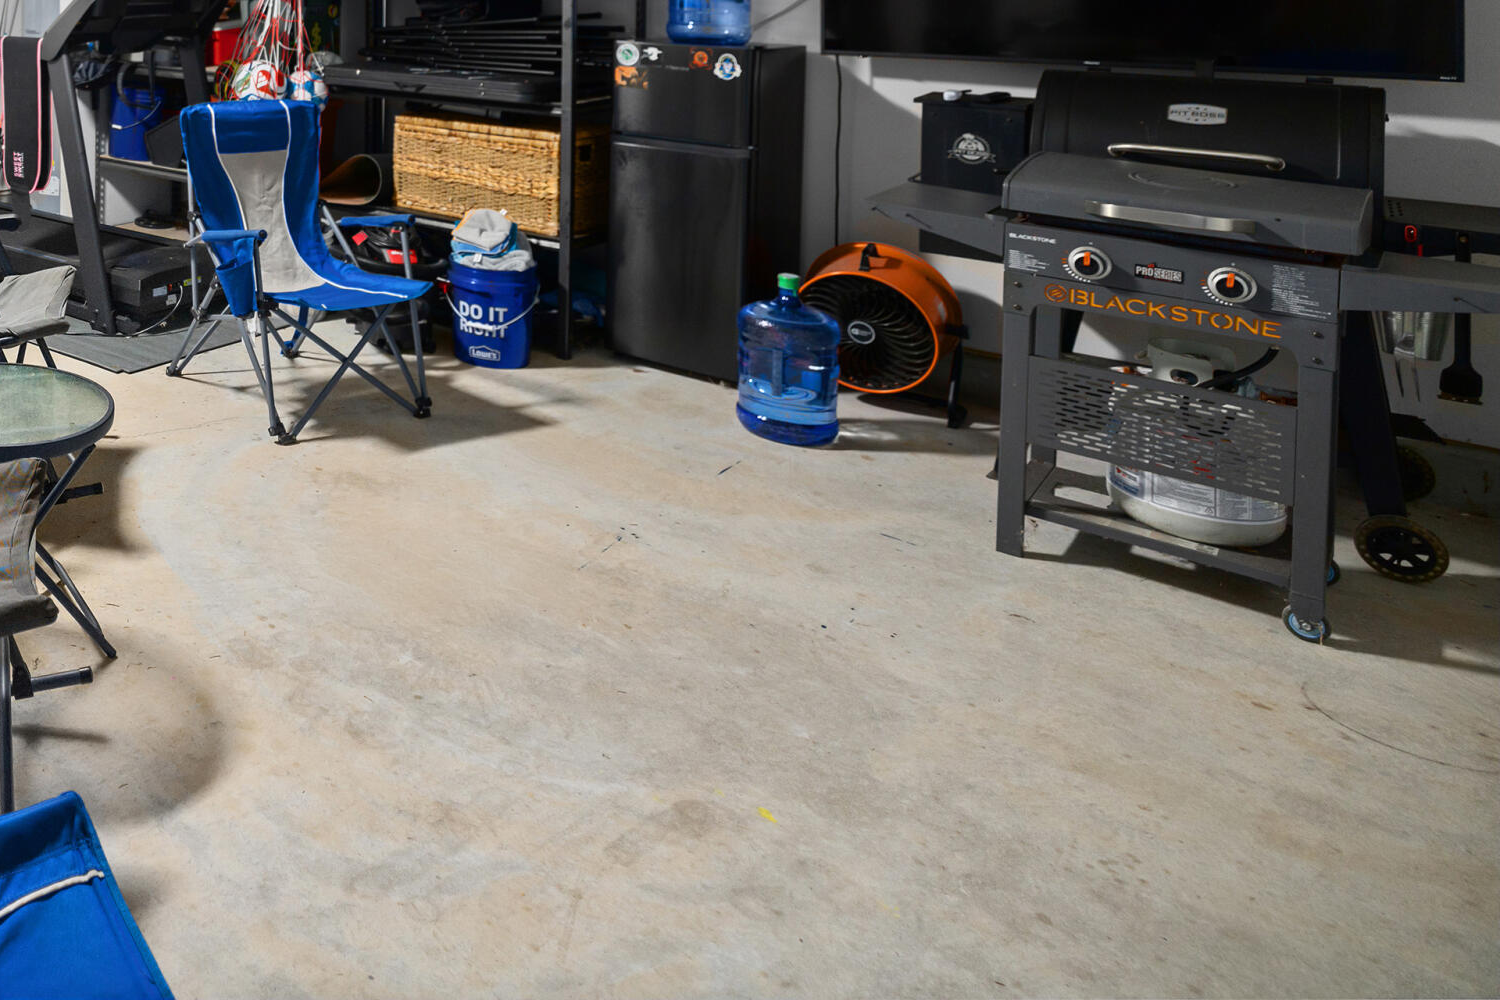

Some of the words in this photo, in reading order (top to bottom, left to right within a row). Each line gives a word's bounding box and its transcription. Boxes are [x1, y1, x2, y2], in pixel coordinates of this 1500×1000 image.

[1008, 232, 1056, 245] BLACKSTONE
[1135, 265, 1154, 276] PRO
[1154, 268, 1183, 282] SERIES
[459, 300, 483, 320] DO
[489, 307, 508, 323] IT
[1068, 288, 1282, 339] BLACKSTONE
